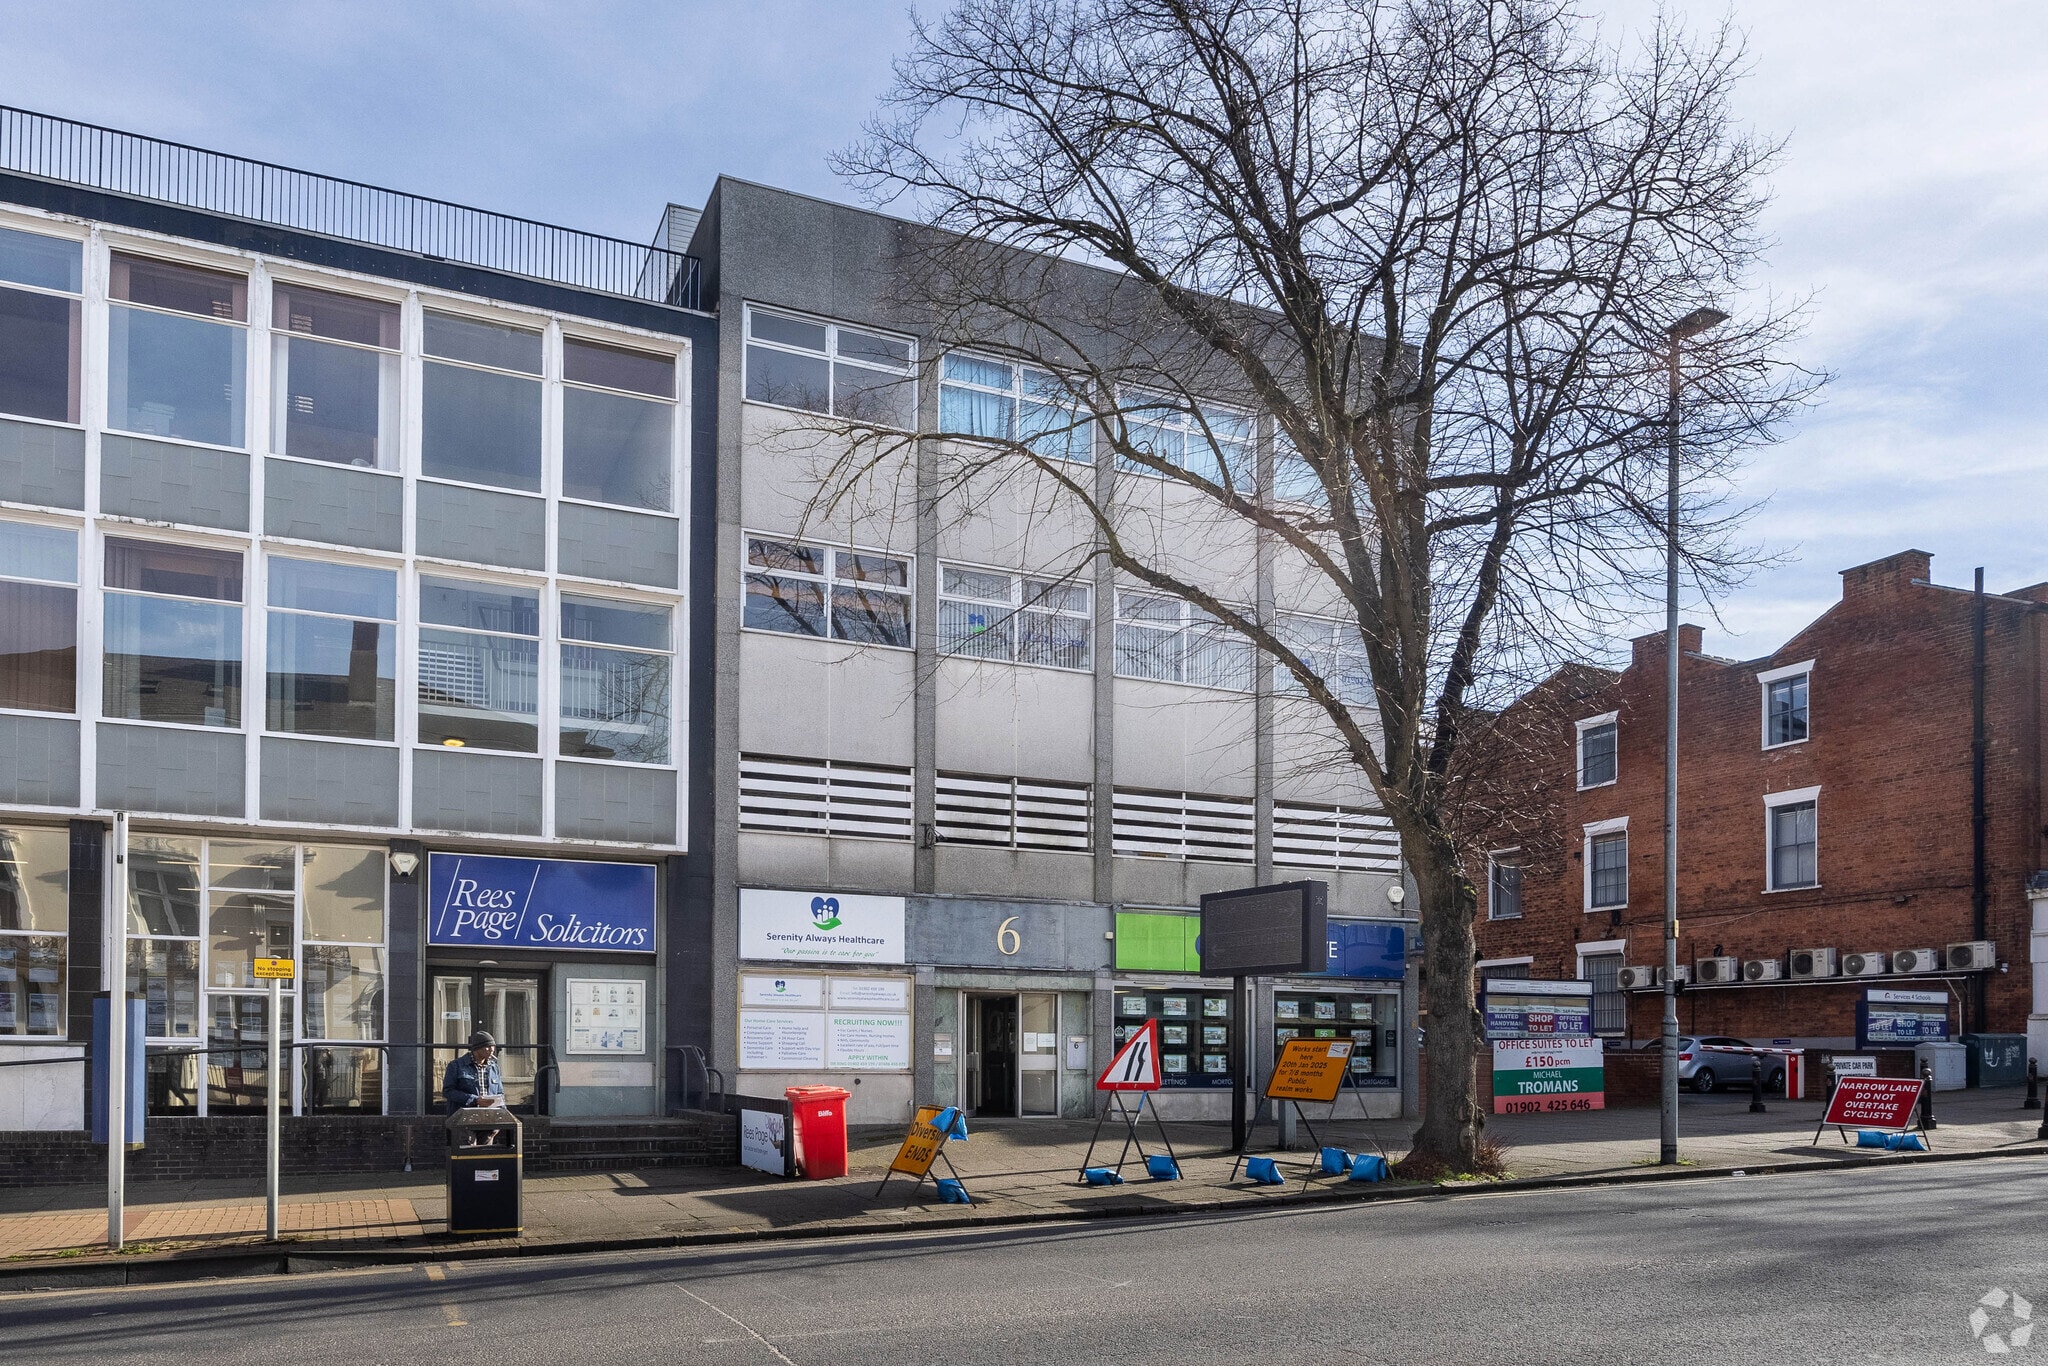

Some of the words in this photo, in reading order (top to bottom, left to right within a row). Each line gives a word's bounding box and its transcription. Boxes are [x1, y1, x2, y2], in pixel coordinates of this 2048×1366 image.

[452, 879, 515, 908] Rees
[450, 910, 517, 939] Page
[530, 914, 647, 945] Solicitors
[766, 933, 803, 942] Serenity
[805, 934, 836, 944] Always
[839, 936, 885, 945] Healthcare
[997, 916, 1021, 955] 6
[1528, 1014, 1553, 1023] SHOP
[1558, 1022, 1568, 1030] TO
[1569, 1022, 1583, 1030] LET
[1499, 1040, 1530, 1050] OFFICE
[1532, 1039, 1562, 1049] SUITES
[1565, 1039, 1577, 1048] TO
[1579, 1038, 1594, 1048] LET
[1525, 1055, 1554, 1068] £150
[1555, 1059, 1571, 1067] pcm
[1834, 1061, 1851, 1070] PRIVATE
[1862, 1062, 1873, 1070] PARK
[1533, 1071, 1562, 1079] MICHAEL
[1518, 1080, 1578, 1094] TROMANS
[1840, 1082, 1888, 1091] NARROW
[1889, 1084, 1918, 1092] LANE
[1855, 1092, 1871, 1100] DO
[1873, 1093, 1896, 1101] NOT
[1505, 1101, 1541, 1113] 01902
[1547, 1100, 1567, 1111] 425
[1570, 1099, 1590, 1110] 646
[1845, 1101, 1899, 1111] OVERTAKE
[1843, 1110, 1894, 1120] CYCLISTS
[744, 1125, 754, 1140] Rees
[755, 1127, 768, 1145] Page
[904, 1145, 932, 1162] ENDS
